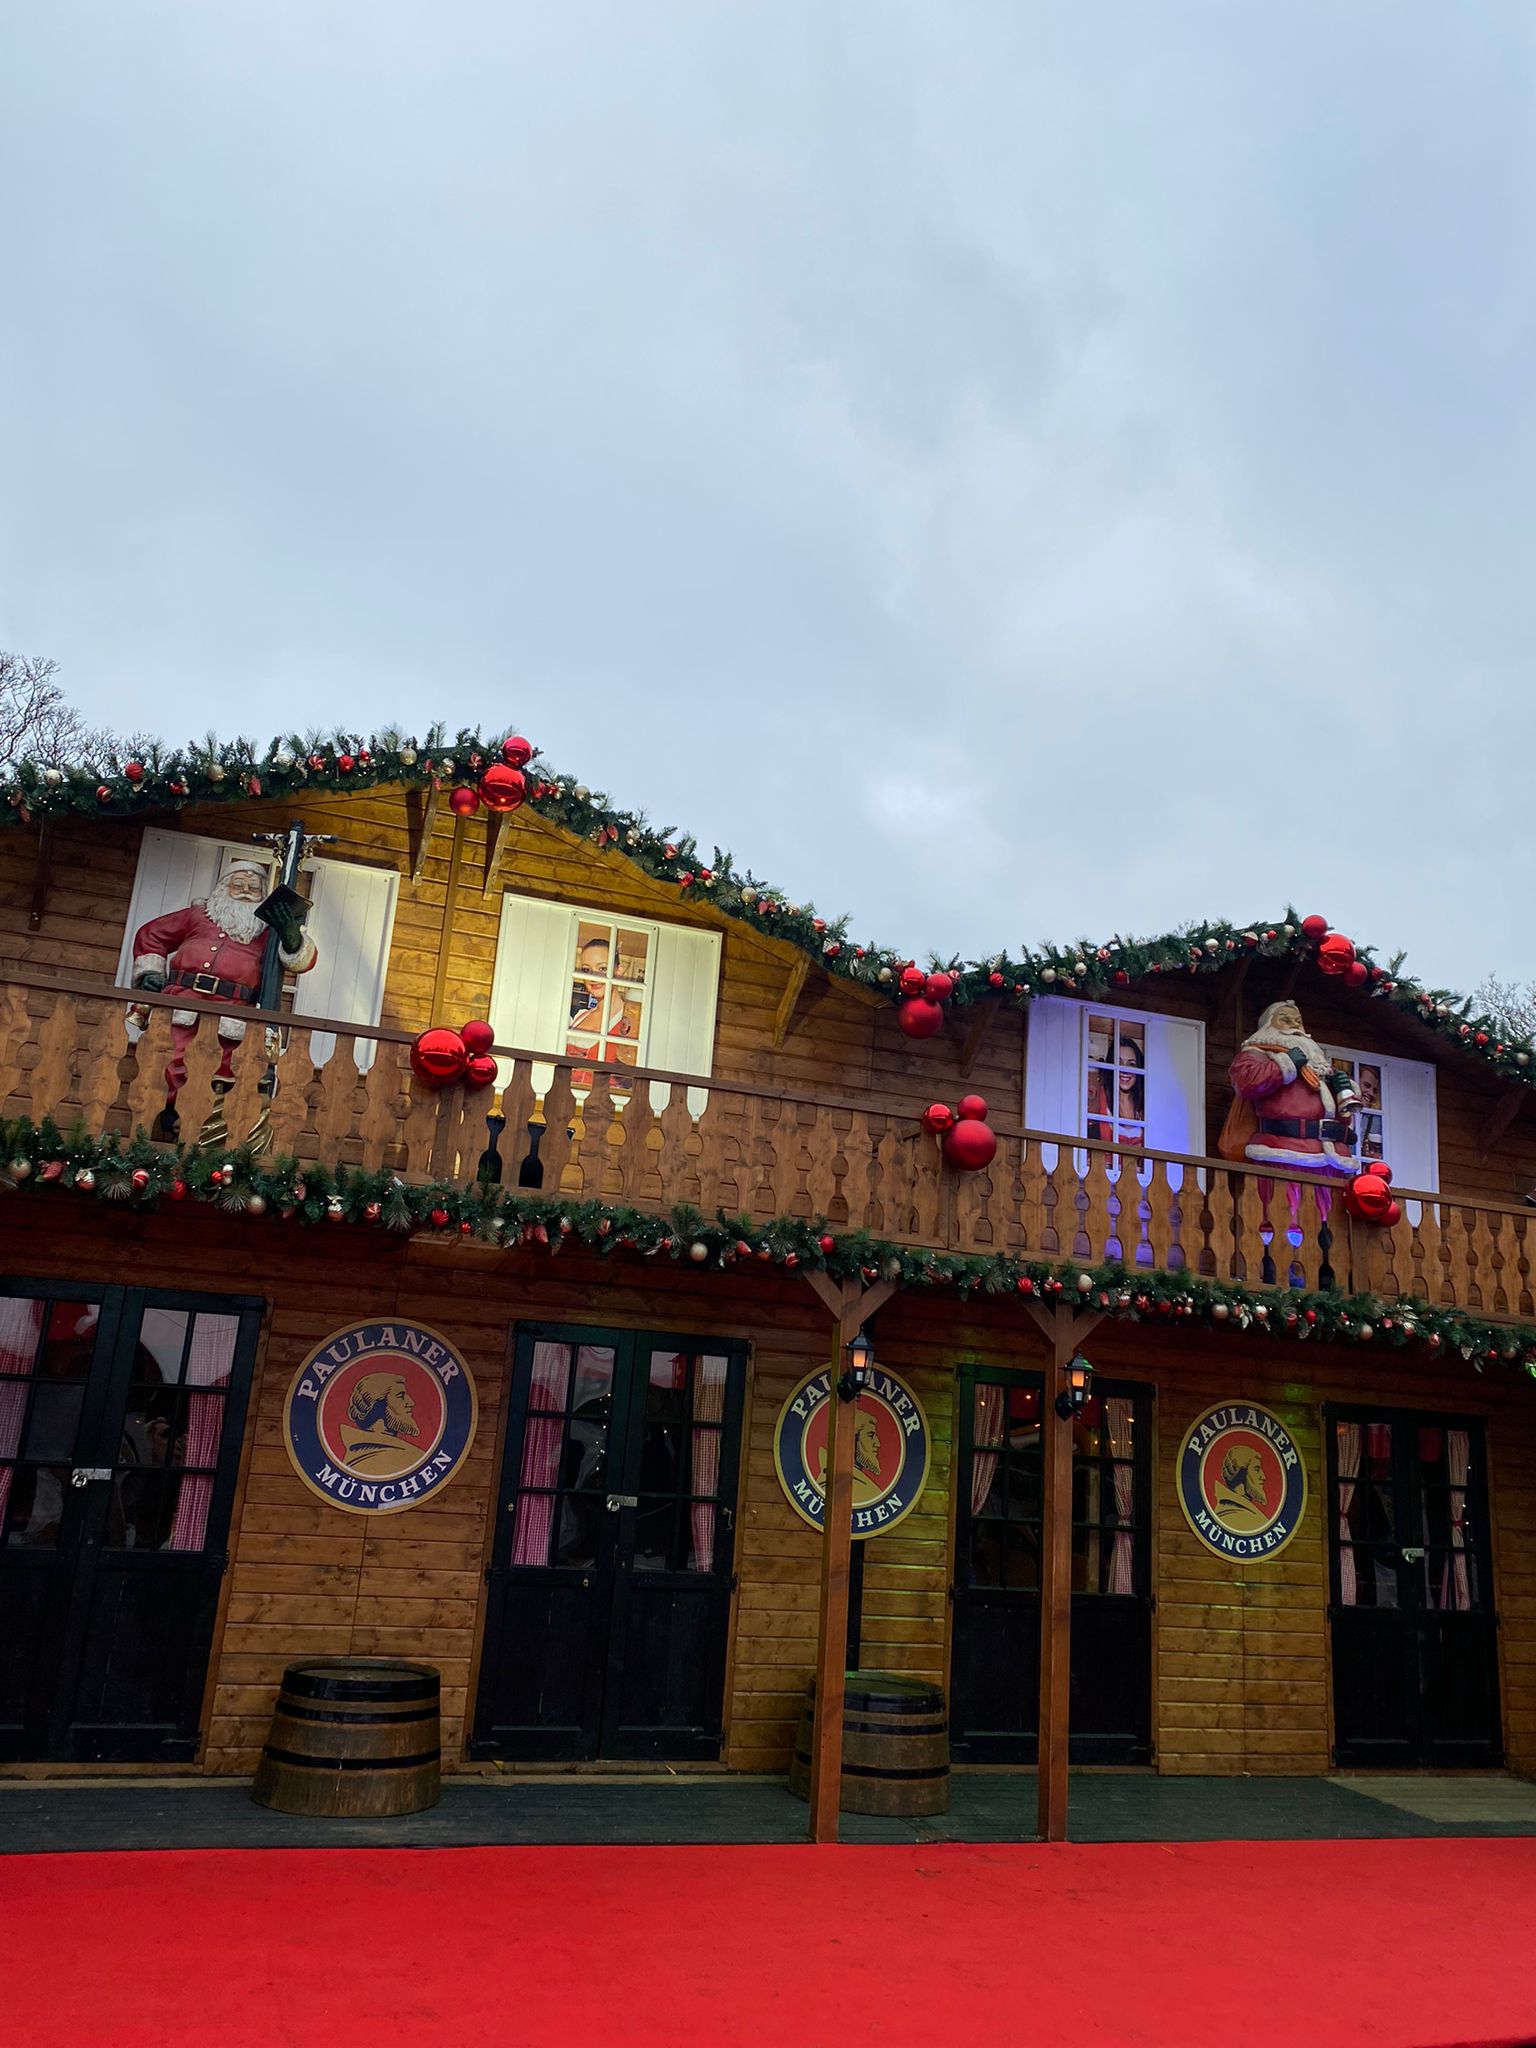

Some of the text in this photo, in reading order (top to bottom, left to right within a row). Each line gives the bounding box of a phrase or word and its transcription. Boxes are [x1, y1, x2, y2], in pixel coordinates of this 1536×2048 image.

[298, 1327, 460, 1401] PAULANER
[1188, 1408, 1298, 1470] PAULANER
[315, 1450, 452, 1502] MÜNCHEN
[793, 1479, 903, 1528] MÜHEN
[1195, 1509, 1287, 1554] MÜNCHEN
